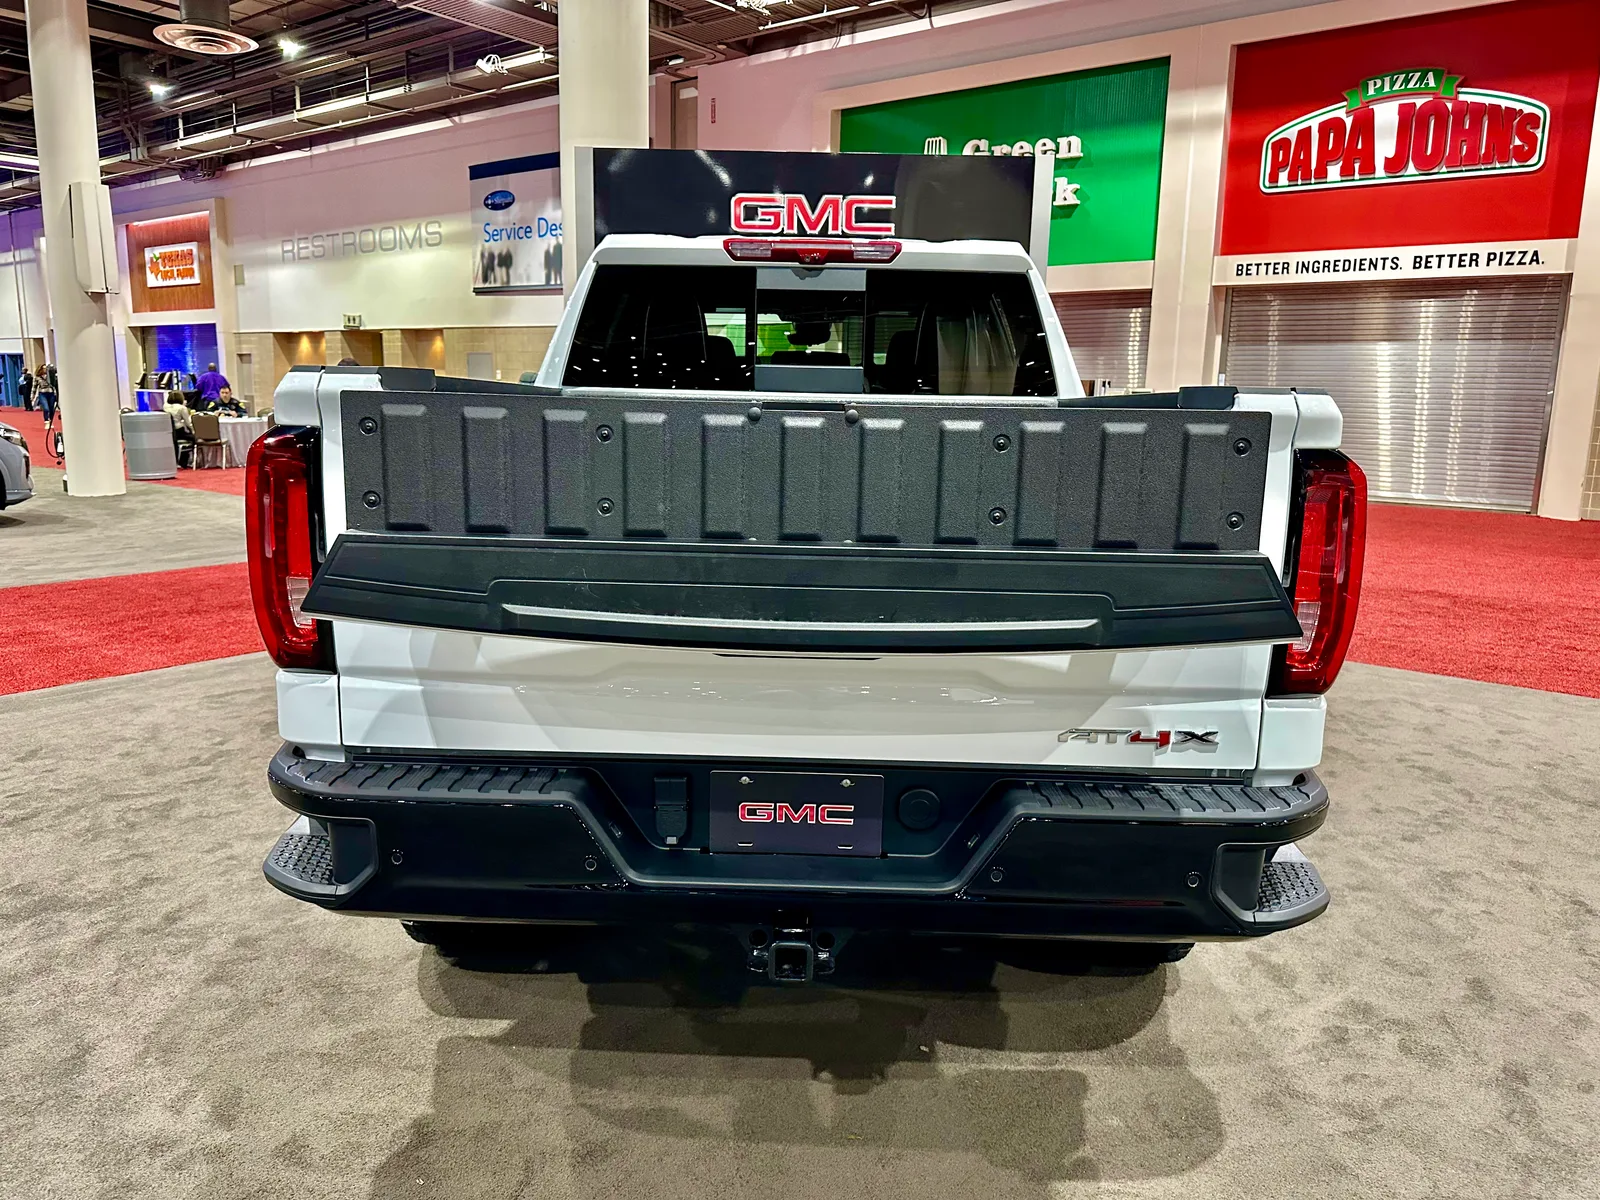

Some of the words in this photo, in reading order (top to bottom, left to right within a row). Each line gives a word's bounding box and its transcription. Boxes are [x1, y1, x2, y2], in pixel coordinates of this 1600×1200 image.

[1366, 71, 1437, 96] PIZZA
[962, 135, 1084, 159] Green
[1268, 107, 1376, 184] PAPA
[1384, 100, 1542, 175] JOHN'S
[731, 193, 896, 235] GMC
[281, 220, 443, 262] RESTROOMS
[483, 222, 533, 243] Service
[1236, 261, 1290, 277] BETTER
[1295, 256, 1403, 275] INGREDIENTS.
[1412, 252, 1480, 270] BETTER
[1486, 249, 1545, 267] PIZZA.
[1058, 728, 1219, 752] AT4X
[738, 802, 854, 825] GMC
